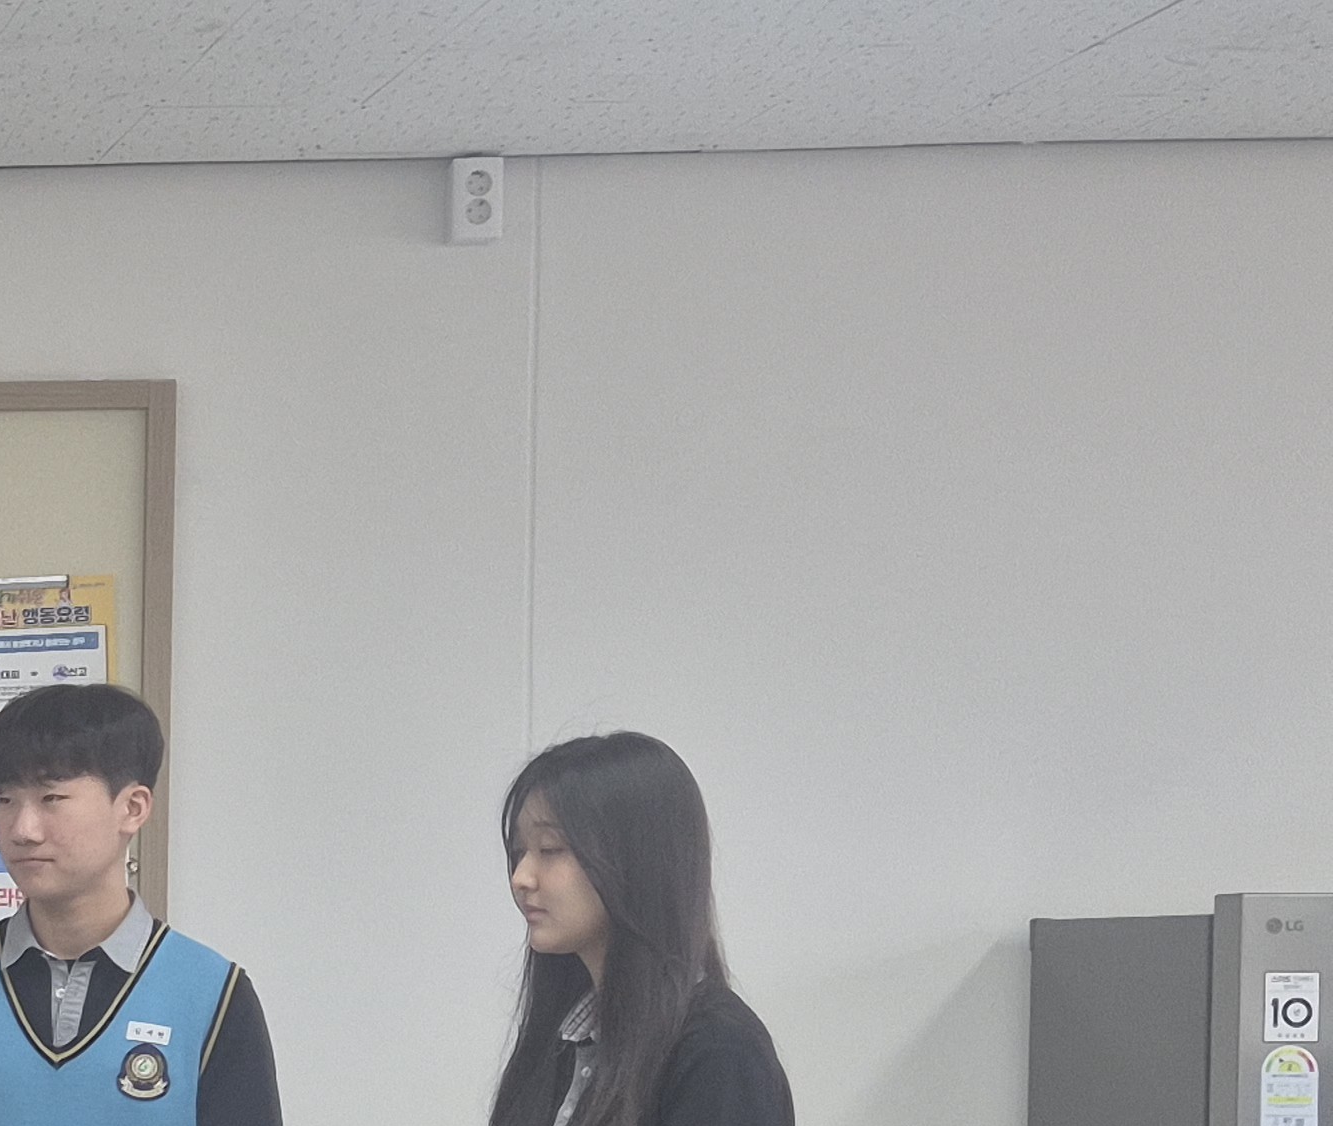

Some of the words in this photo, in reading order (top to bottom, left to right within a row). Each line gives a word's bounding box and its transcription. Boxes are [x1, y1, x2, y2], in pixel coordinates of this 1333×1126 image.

[21, 605, 91, 625] 행동요령
[1285, 920, 1304, 932] LG
[1271, 997, 1313, 1028] 10
